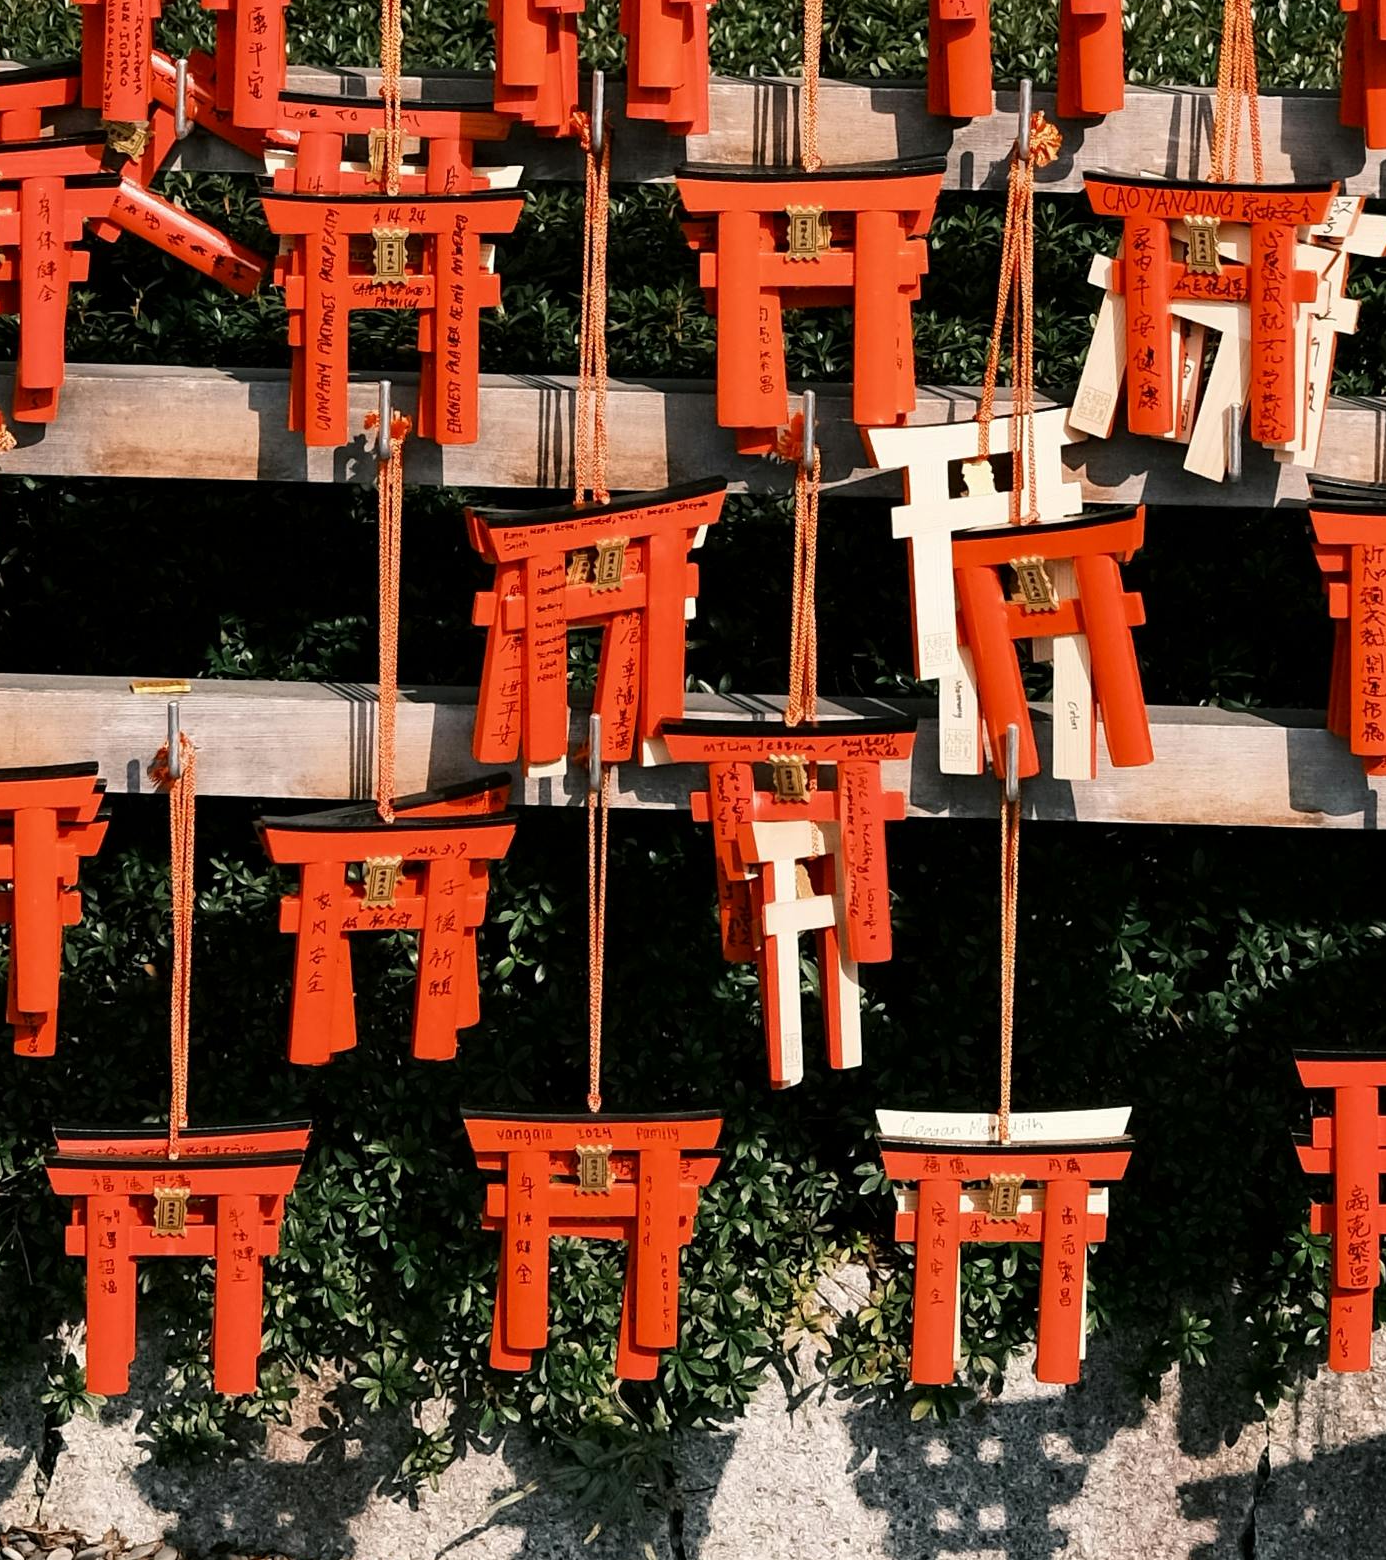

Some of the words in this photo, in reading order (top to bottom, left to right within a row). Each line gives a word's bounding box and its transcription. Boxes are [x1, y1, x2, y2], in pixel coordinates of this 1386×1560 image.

[305, 890, 334, 996] 家内安全
[929, 1201, 951, 1306] 家内安全
